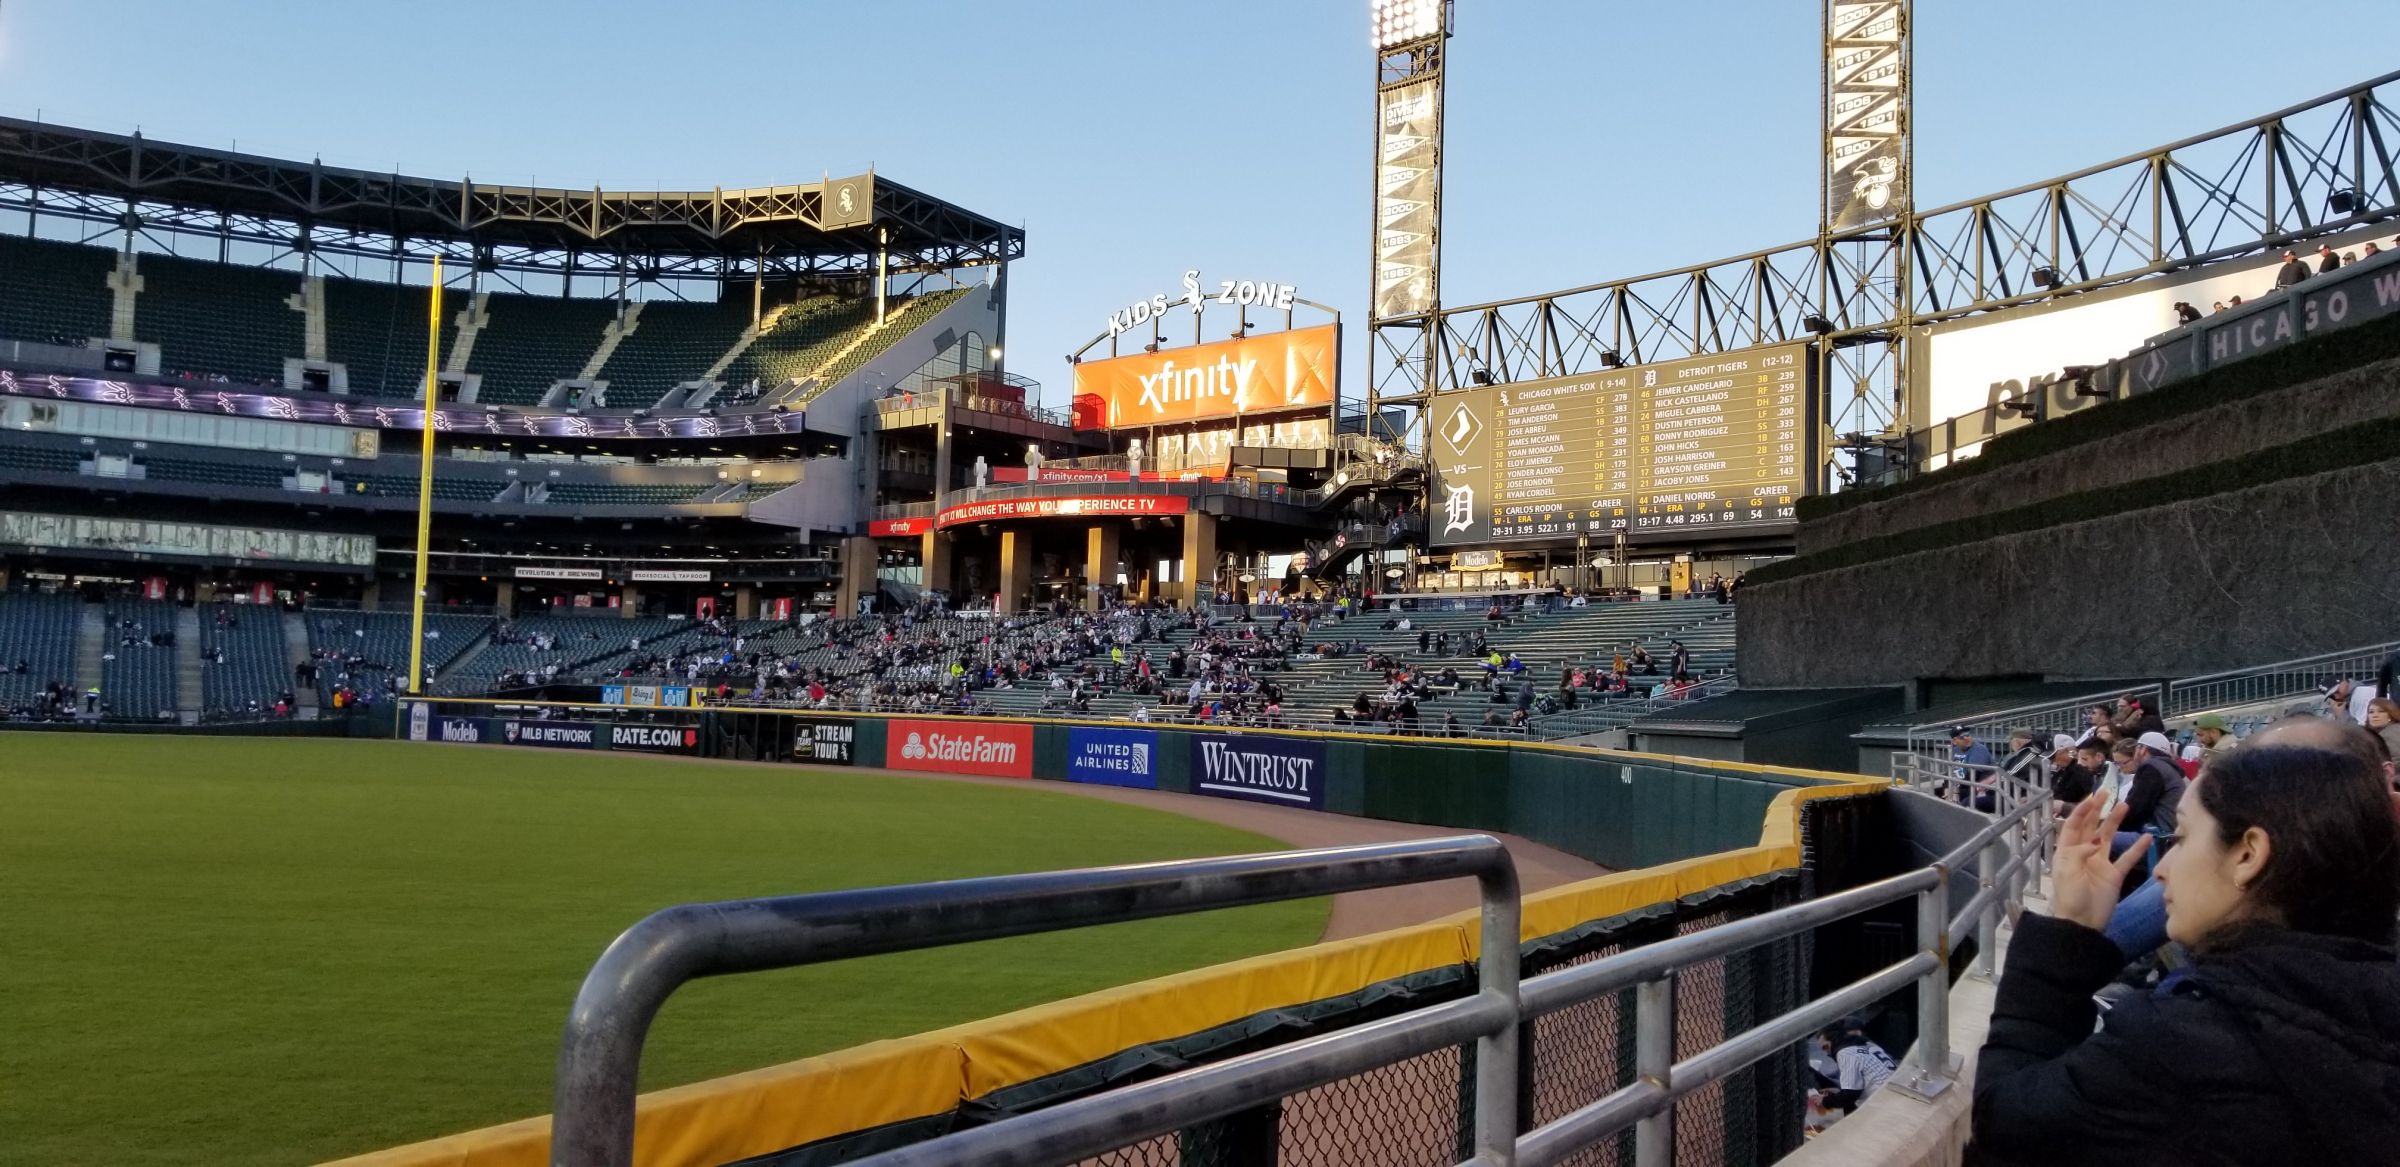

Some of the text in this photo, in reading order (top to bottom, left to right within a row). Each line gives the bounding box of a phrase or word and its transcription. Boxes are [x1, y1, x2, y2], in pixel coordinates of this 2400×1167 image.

[1859, 18, 1894, 38] 1959
[1837, 50, 1871, 68] 1919
[1861, 64, 1896, 82] 1917
[1860, 111, 1894, 128] 1901
[1836, 140, 1871, 158] 1900
[1384, 203, 1413, 216] 2000
[1107, 293, 1168, 338] KIDS
[1217, 280, 1297, 311] ZONE
[2191, 290, 2348, 361] HICAGO
[1678, 364, 1715, 379] DETROIT
[1718, 360, 1748, 373] TIGERS
[1762, 354, 1793, 368] (12-12)
[1138, 353, 1257, 414] xfinity
[1519, 388, 1551, 400] CHICAGO
[1554, 386, 1577, 396] WHITE
[1580, 382, 1595, 391] SOX
[1655, 386, 1681, 397] JEIMER
[1683, 379, 1733, 393] CANDELARIO
[1655, 398, 1673, 408] NICK
[1674, 392, 1729, 406] CASTELLANOS
[1509, 406, 1529, 416] LEURY
[1530, 403, 1555, 413] GARCIA
[1655, 408, 1684, 419] MIGUEL
[1686, 404, 1721, 416] CABRERA
[1522, 413, 1558, 424] ANDERSON
[1654, 420, 1683, 430] DUSTIN
[1684, 415, 1724, 428] PETERSON
[1507, 428, 1524, 437] JOSE
[1524, 425, 1547, 434] ABREU
[1654, 431, 1683, 442] RONNY
[1683, 426, 1729, 439] RODRIGUEZ
[1507, 438, 1529, 447] JAMES
[1530, 435, 1560, 444] MCCANN
[1654, 443, 1675, 453] JOHN
[1677, 440, 1699, 450] HICKS
[1507, 448, 1527, 457] YOAN
[1528, 445, 1564, 455] MONCADA
[1654, 454, 1674, 464] JOSH
[1675, 451, 1715, 462] HARRISON
[1454, 464, 1467, 474] VS
[1507, 459, 1524, 468] ELOY
[1526, 456, 1553, 466] JIMENEZ
[1654, 464, 1692, 475] GRAYSON
[1693, 461, 1726, 472] GREINER
[1042, 472, 1108, 484] xfinity.com/x1
[1507, 469, 1535, 479] YONDER
[1536, 466, 1564, 475] ALONSO
[1654, 476, 1684, 487] JACOBY
[1685, 474, 1709, 484] JONES
[1506, 480, 1522, 489] JOSE
[1523, 478, 1553, 487] RONDON
[1506, 490, 1525, 499] RYAN
[1526, 487, 1556, 497] CORDELL
[1652, 494, 1683, 504] DANIEL
[1684, 491, 1716, 502] NORRIS
[1754, 485, 1788, 495] CAREER
[968, 505, 996, 517] CHANGE
[998, 502, 1014, 514] THE
[1016, 501, 1037, 513] WAY
[1139, 499, 1156, 510] TV
[1505, 504, 1533, 515] CARLOS
[1535, 503, 1562, 513] RODON
[1592, 499, 1622, 509] CAREER
[1666, 495, 1791, 513] ERA IP G GS ER
[1517, 515, 1532, 523] ERA
[1544, 513, 1551, 521] IP
[1589, 510, 1600, 518] GS
[1613, 508, 1624, 516] ER
[1638, 507, 1794, 526] 13-17 4.48 295.1 69 54 147
[890, 521, 911, 533] xfinity
[1492, 518, 1626, 536] 29-31 3.95 522.1 91 88 229
[1464, 554, 1489, 566] Modelo
[442, 721, 478, 742] Modelo
[521, 726, 542, 740] MLB
[544, 728, 591, 743] NETWORK
[612, 727, 682, 746] RATE.COM
[815, 725, 853, 742] STREAM
[814, 742, 839, 759] YOUR
[1086, 743, 1130, 756] UNITED
[1075, 756, 1129, 770] AIRLINES
